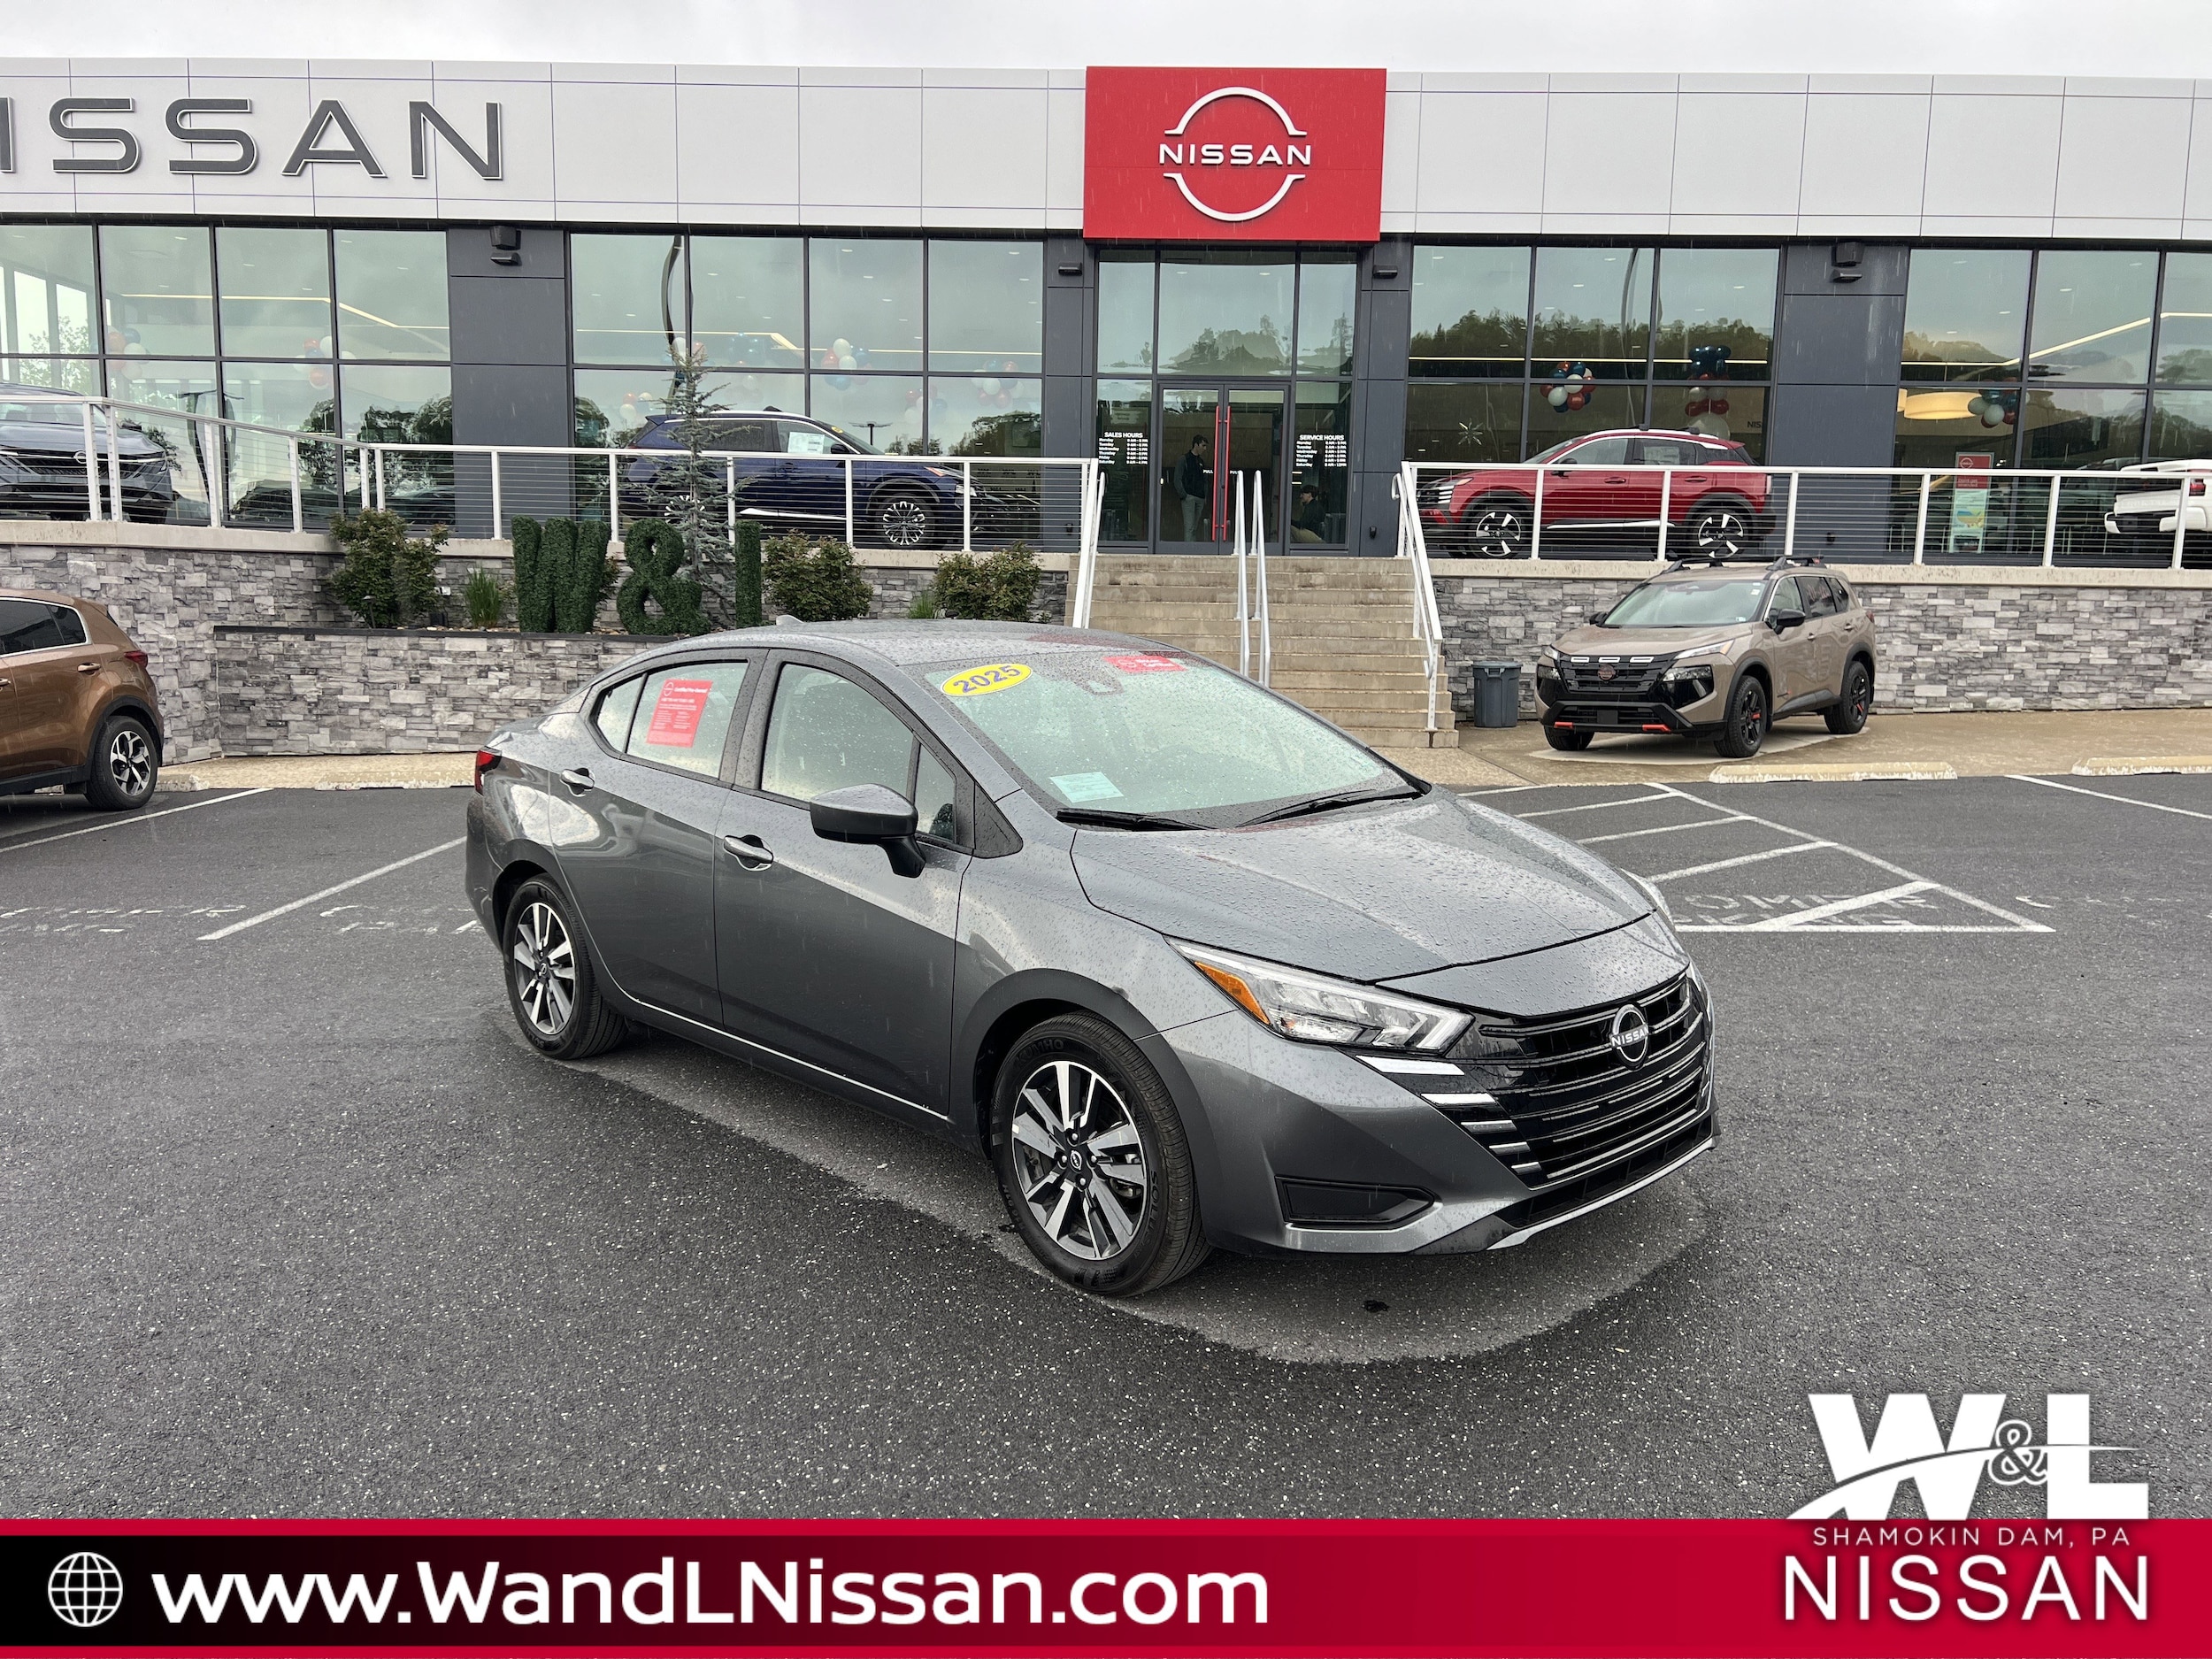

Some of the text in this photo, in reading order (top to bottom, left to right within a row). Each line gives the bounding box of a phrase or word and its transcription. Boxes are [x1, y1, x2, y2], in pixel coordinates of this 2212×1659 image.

[0, 96, 503, 180] ISSAN
[1159, 143, 1311, 165] NISSAN
[953, 665, 1020, 693] 2025
[1611, 1026, 1648, 1047] NISSAN
